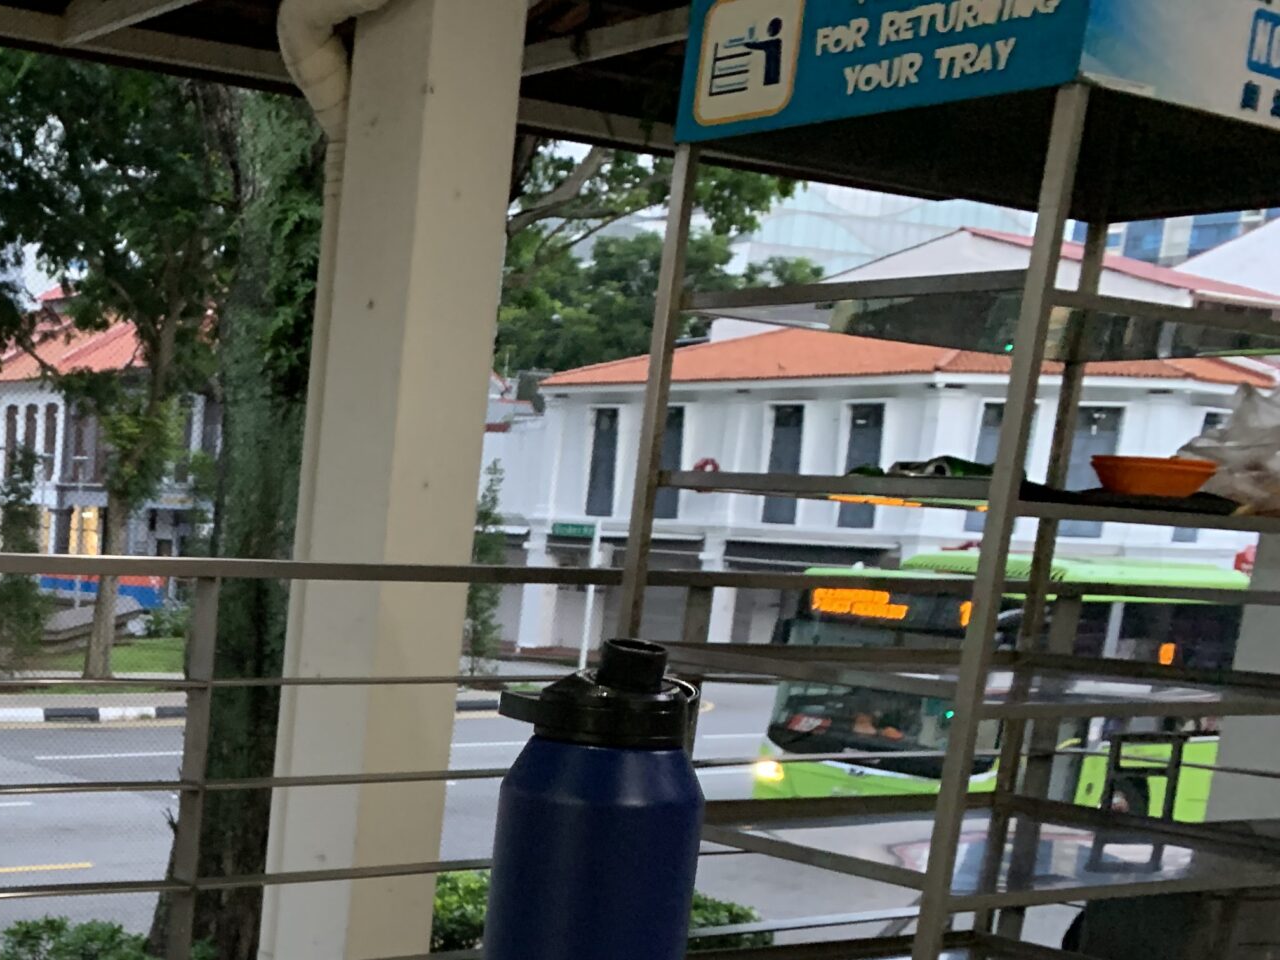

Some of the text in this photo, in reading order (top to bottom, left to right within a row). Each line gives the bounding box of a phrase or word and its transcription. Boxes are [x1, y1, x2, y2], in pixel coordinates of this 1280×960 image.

[816, 0, 1061, 56] FOR RETURNING
[843, 37, 1016, 95] YOUR TRAY
